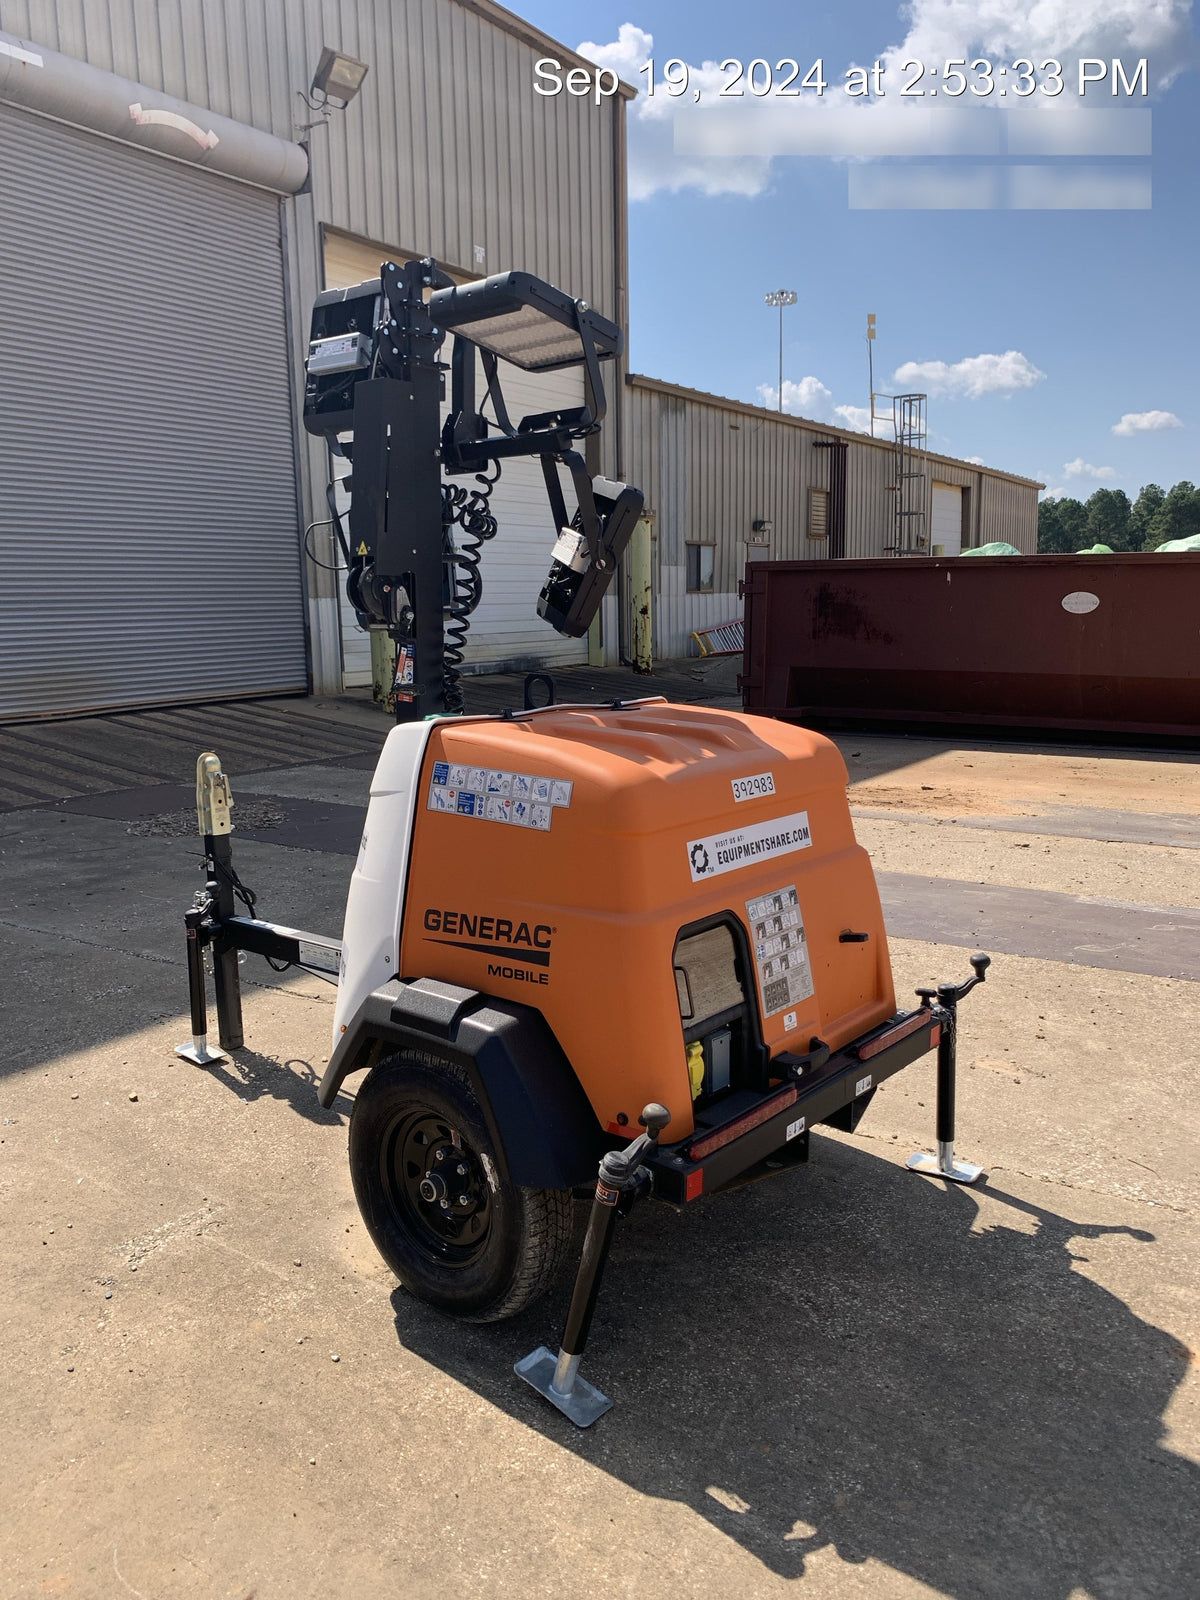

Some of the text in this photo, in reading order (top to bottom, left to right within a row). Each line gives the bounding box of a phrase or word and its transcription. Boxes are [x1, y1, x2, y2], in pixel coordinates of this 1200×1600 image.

[733, 776, 774, 799] 392983
[715, 838, 728, 848] VISIT
[729, 836, 736, 845] US
[717, 826, 810, 865] EQUIPMENTSHARE.COM
[423, 908, 552, 949] GENERAC
[487, 964, 549, 985] MOBILE
